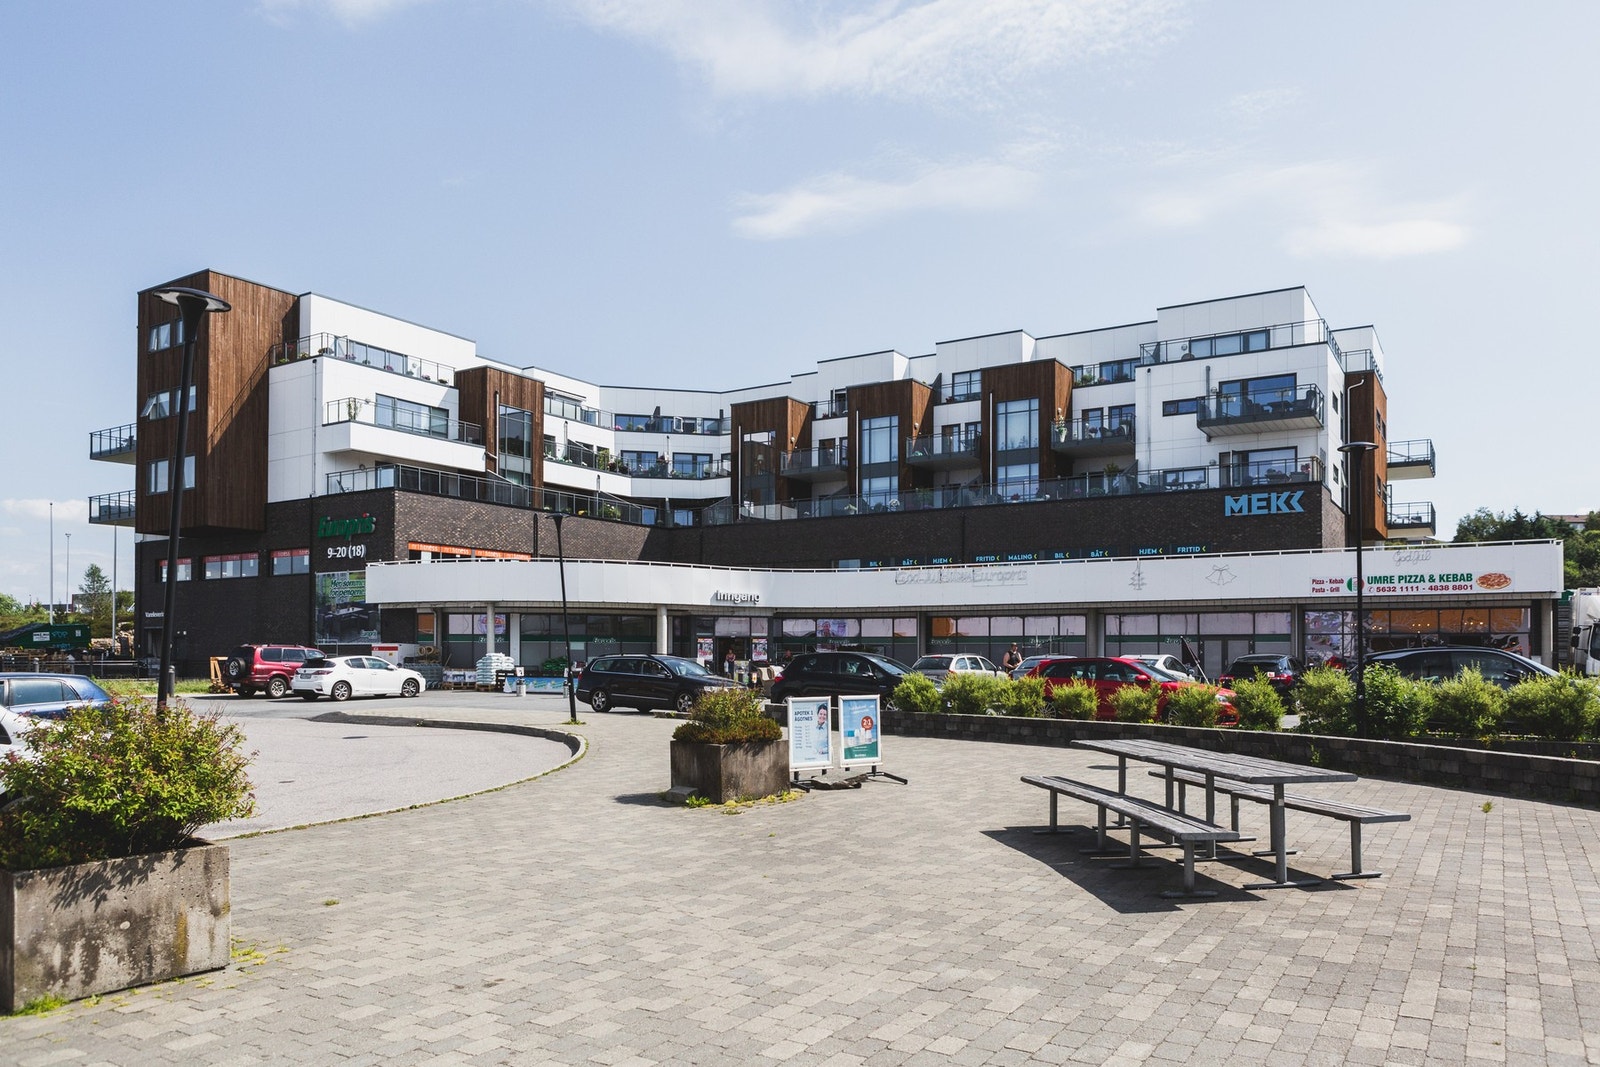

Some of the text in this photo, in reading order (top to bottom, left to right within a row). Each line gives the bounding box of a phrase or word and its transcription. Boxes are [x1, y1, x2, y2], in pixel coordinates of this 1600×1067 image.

[318, 512, 376, 541] Europris
[348, 544, 365, 559] (18)
[1008, 553, 1033, 561] MALING
[1367, 575, 1395, 585] UMRE
[1398, 574, 1426, 584] PIZZA
[1428, 574, 1436, 583] &
[1438, 572, 1473, 583] KEBAB
[715, 590, 760, 604] Inngang
